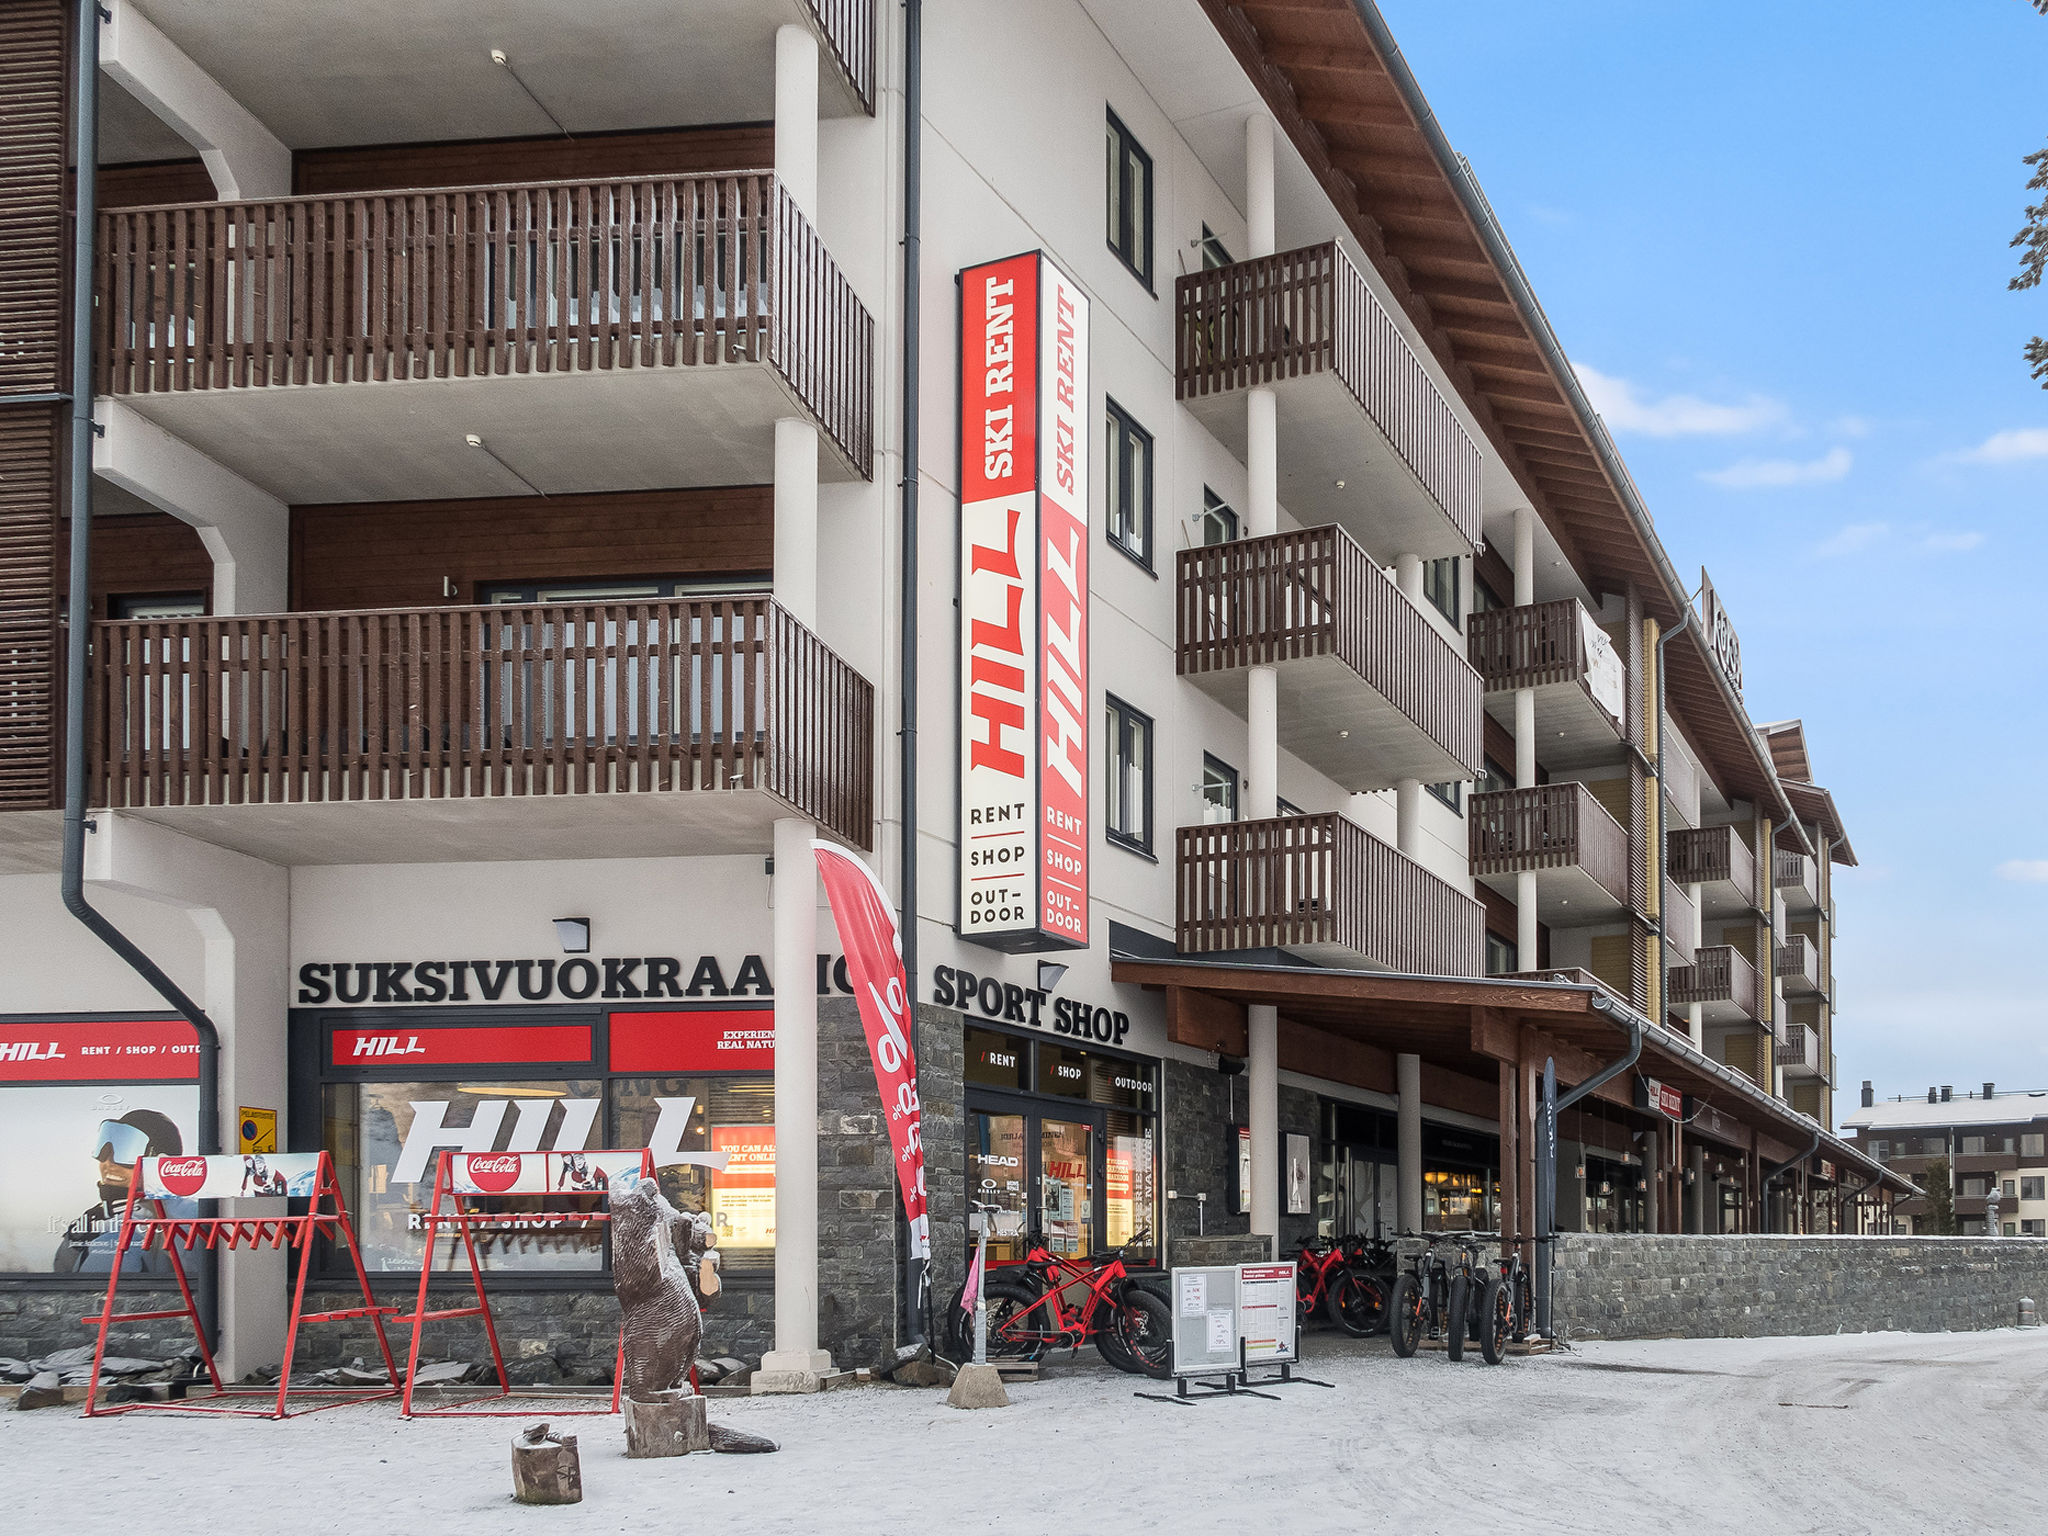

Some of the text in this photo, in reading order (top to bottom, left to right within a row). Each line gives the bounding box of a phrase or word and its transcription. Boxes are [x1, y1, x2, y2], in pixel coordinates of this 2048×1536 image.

[985, 276, 1014, 481] SKI RENT
[1056, 284, 1074, 496] SKI RENT
[971, 508, 1025, 779] HILL
[1047, 525, 1082, 799] HILL
[971, 802, 1025, 825] RENT
[1046, 805, 1082, 835] RENT
[971, 846, 1025, 866] SHOP
[1046, 848, 1082, 876] SHOP
[971, 888, 1021, 906] OUT-
[1046, 890, 1080, 912] OUT-
[971, 906, 1025, 924] DOOR
[1046, 907, 1082, 934] DOOR
[934, 964, 1130, 1045] SPORT SHOP
[0, 1042, 66, 1061] HILL
[81, 1046, 111, 1055] RENT
[126, 1046, 157, 1055] SHOP
[353, 1036, 426, 1057] HILL
[717, 1040, 745, 1050] REAL
[989, 1052, 1016, 1068] RENT
[1057, 1065, 1082, 1080] SHOP
[1115, 1076, 1153, 1093] OUTDOOR
[741, 1144, 761, 1153] CAN
[160, 1159, 205, 1177] Coca-Cola
[469, 1155, 519, 1174] Coca-Cola
[977, 1153, 1019, 1167] HEAD
[1048, 1161, 1086, 1179] HILL
